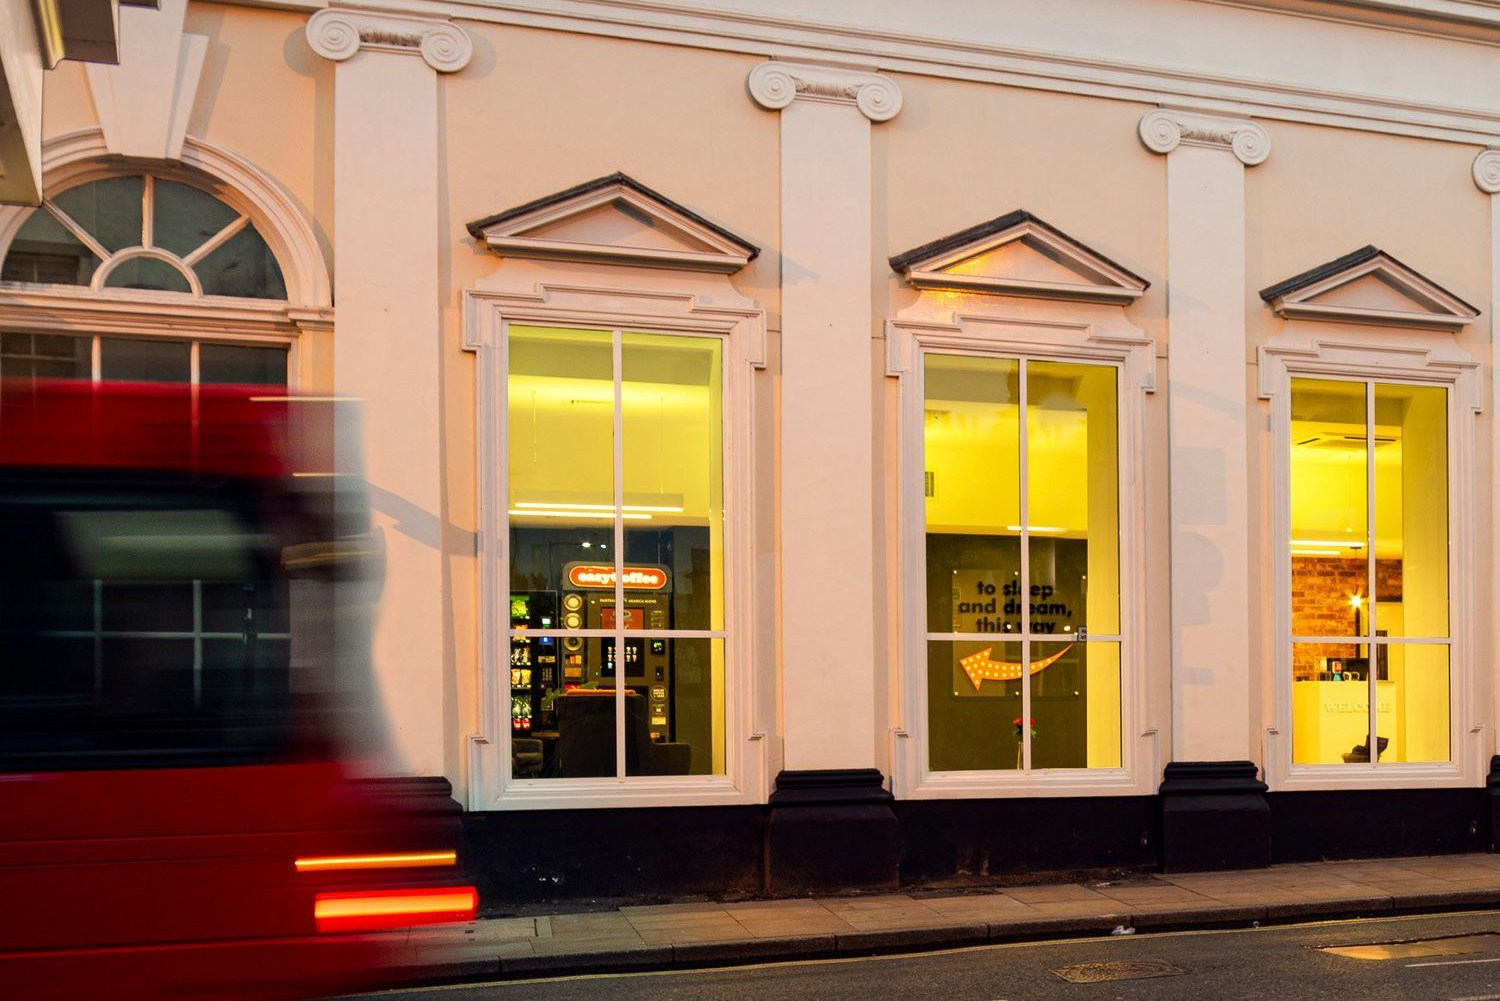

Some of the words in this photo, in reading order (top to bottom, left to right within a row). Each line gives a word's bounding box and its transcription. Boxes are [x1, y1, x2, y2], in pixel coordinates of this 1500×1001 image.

[977, 581, 996, 595] to
[1003, 579, 1053, 600] slep
[958, 598, 996, 613] and
[976, 617, 1011, 633] this
